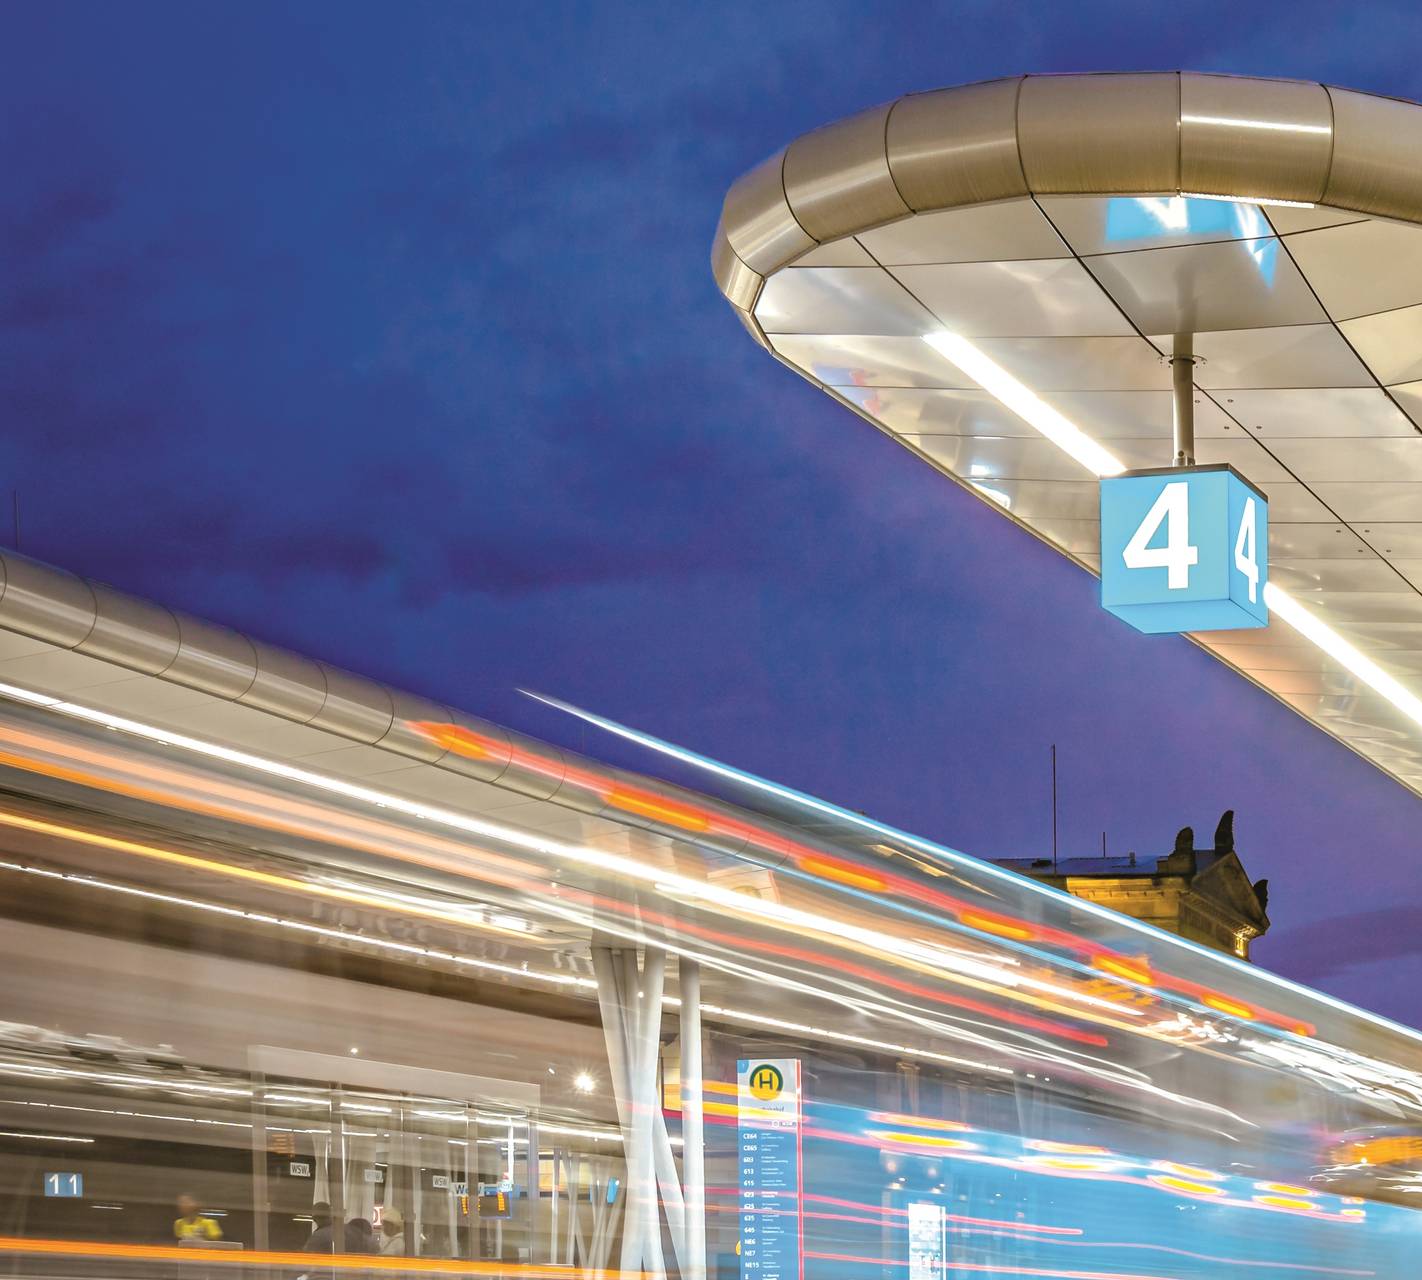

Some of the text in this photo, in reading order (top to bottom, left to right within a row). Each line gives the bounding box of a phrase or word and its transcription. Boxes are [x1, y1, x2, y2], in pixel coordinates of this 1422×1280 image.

[1123, 482, 1198, 589] 4
[1234, 496, 1259, 605] 4
[759, 1072, 774, 1090] H
[291, 1165, 309, 1176] WSW
